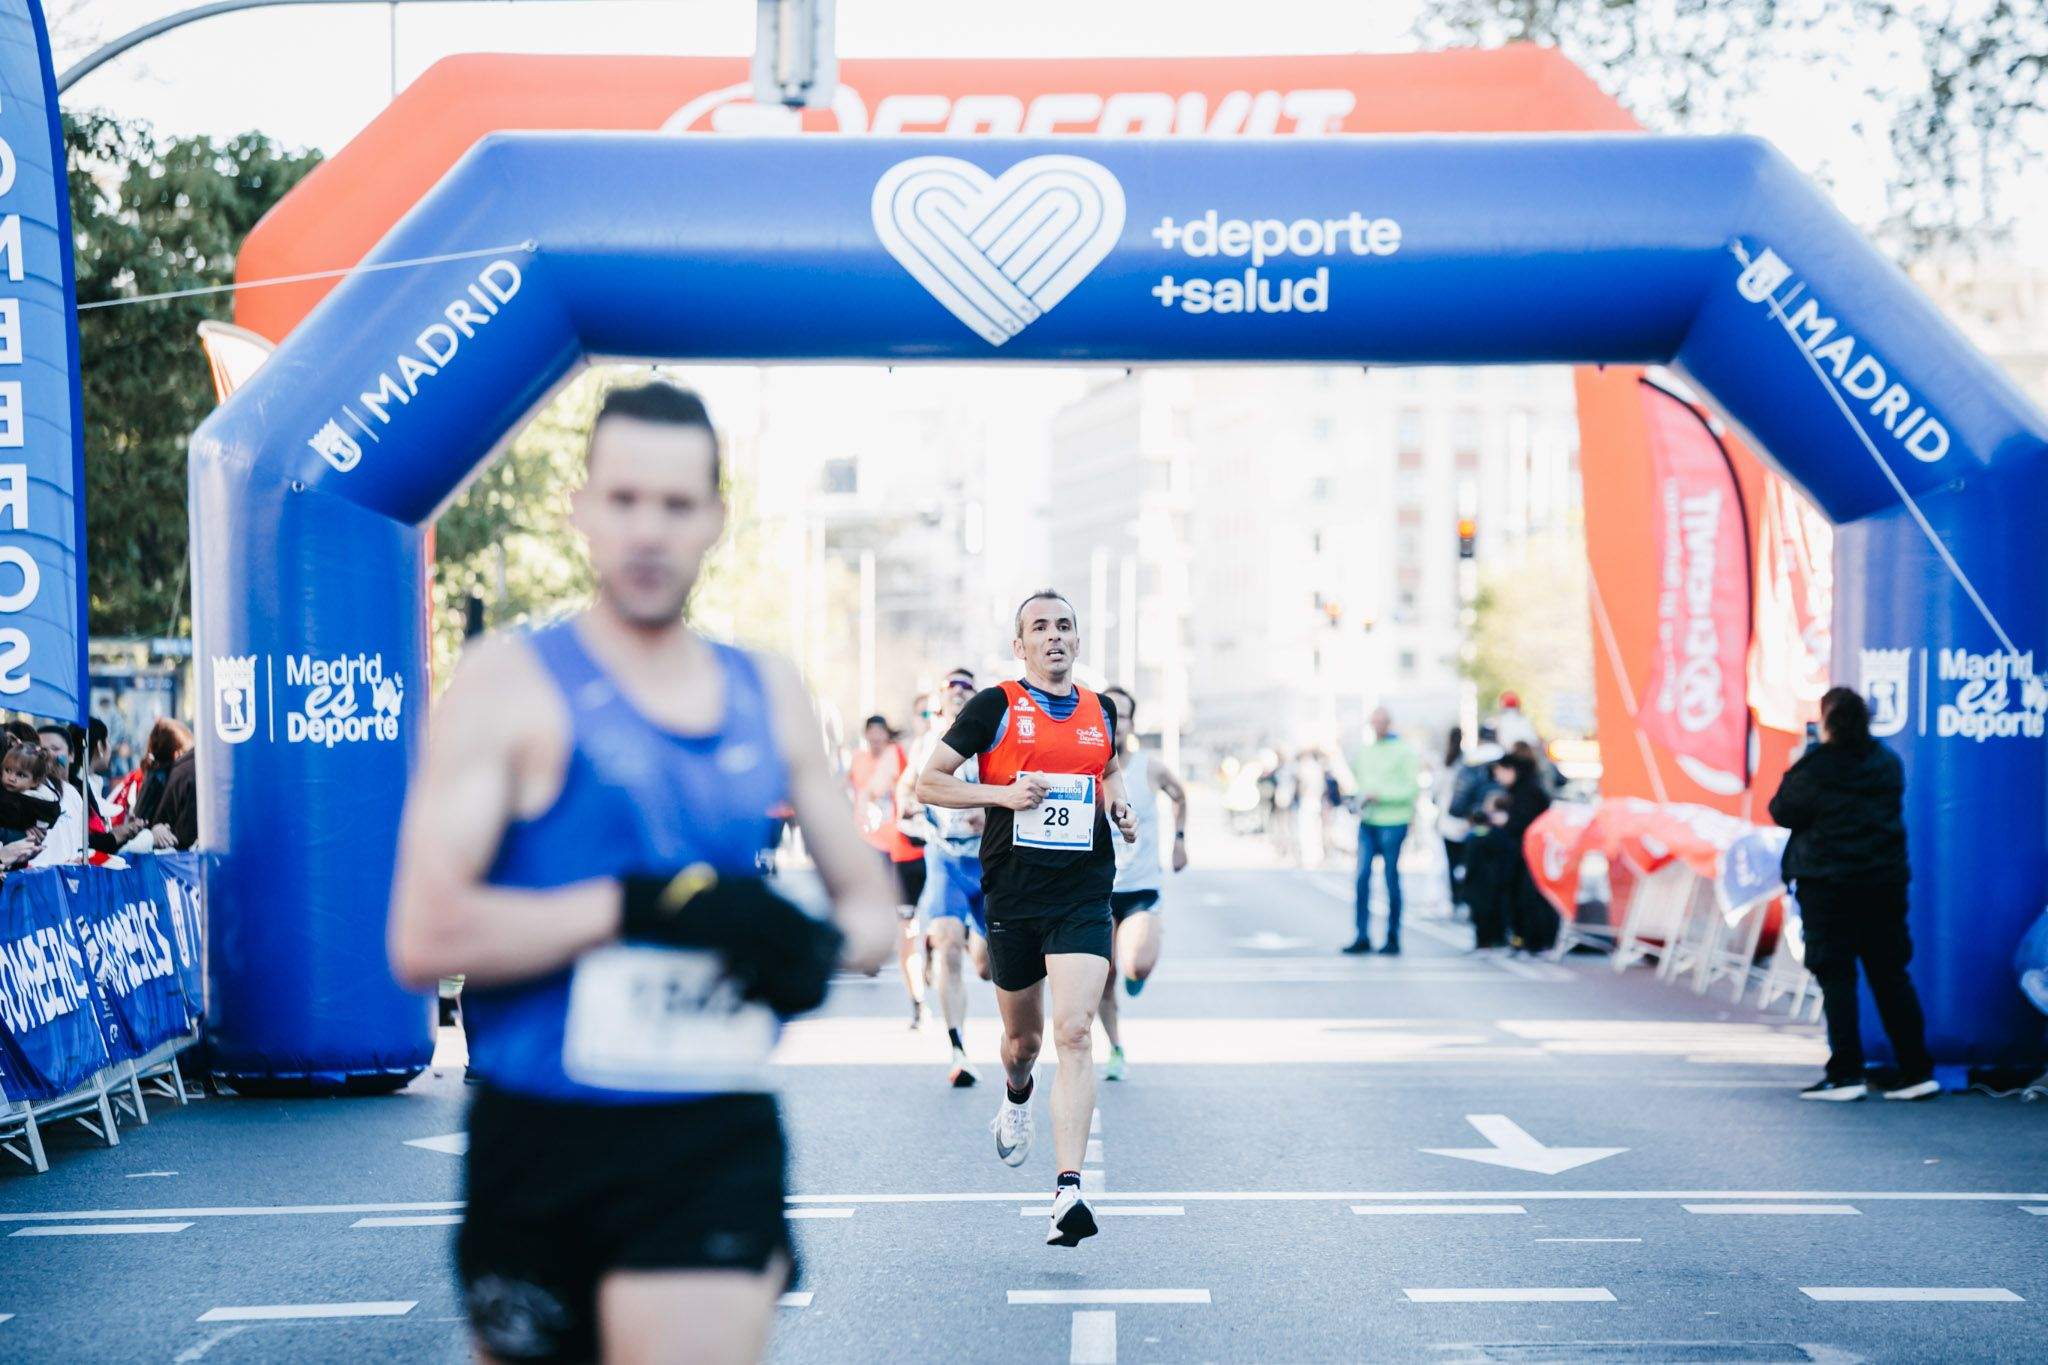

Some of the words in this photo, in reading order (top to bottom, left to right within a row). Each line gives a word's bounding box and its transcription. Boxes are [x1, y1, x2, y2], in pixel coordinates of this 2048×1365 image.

[1152, 209, 1402, 268] +deporte
[1152, 266, 1330, 314] +salud
[360, 259, 522, 425] MADRID
[1788, 298, 1951, 463] MADRID
[286, 652, 382, 686] Madrid
[1938, 647, 2034, 682] Madrid
[304, 683, 359, 719] es
[1955, 678, 2012, 715] es
[286, 710, 399, 749] Deporte
[1936, 703, 2046, 743] Deporte
[1043, 806, 1070, 827] 28
